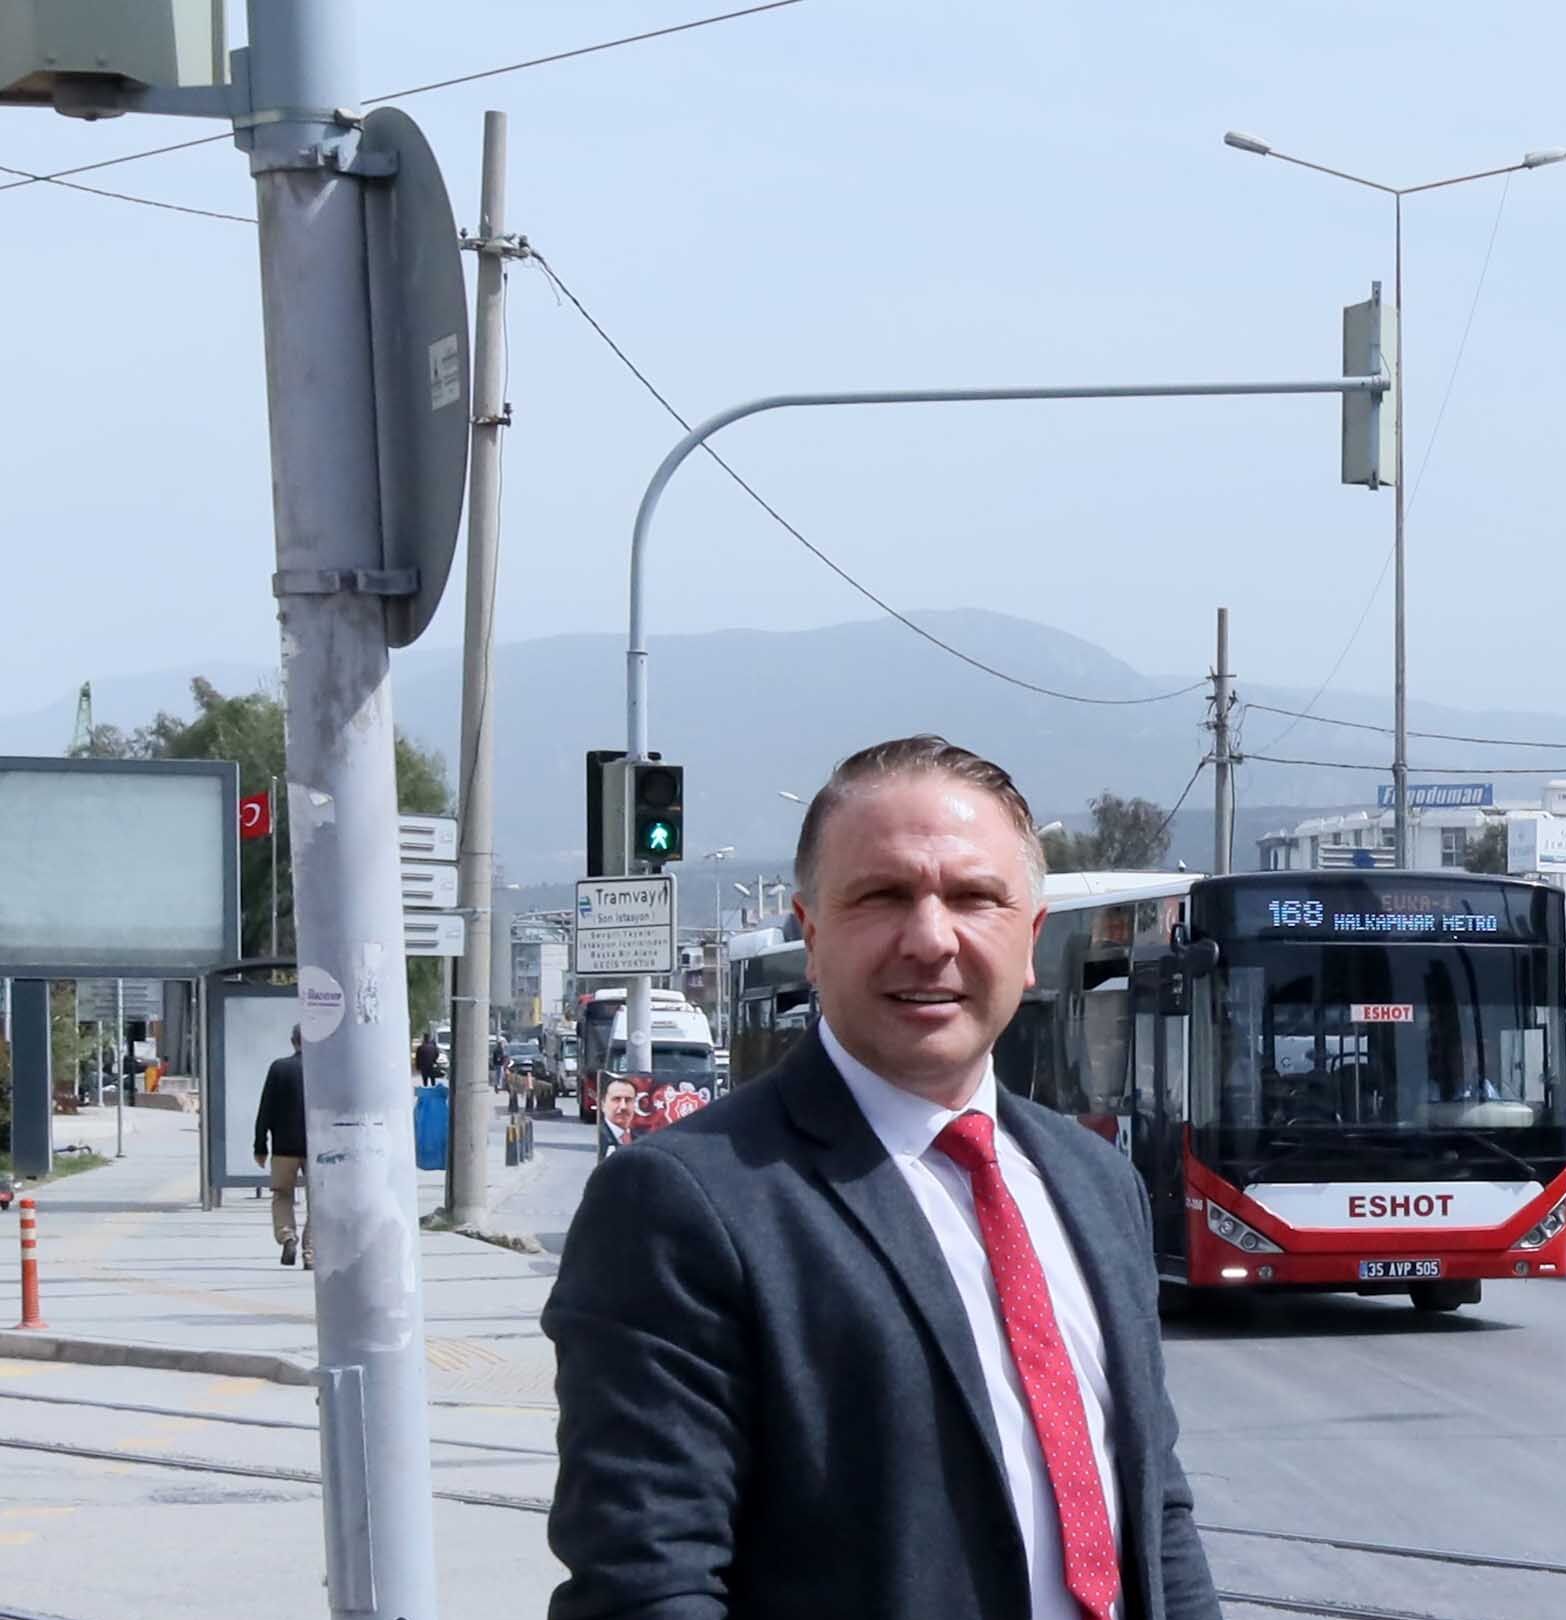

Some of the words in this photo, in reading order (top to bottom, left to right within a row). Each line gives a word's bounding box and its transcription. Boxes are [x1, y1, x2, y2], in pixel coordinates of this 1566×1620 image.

[596, 888, 656, 907] Tramvay
[1268, 900, 1324, 927] 168
[1442, 914, 1498, 932] METRO
[1364, 1006, 1411, 1020] ESHOT
[1348, 1195, 1454, 1218] ESHOT
[1368, 1262, 1384, 1276] 35
[1389, 1262, 1413, 1276] AVP
[1416, 1261, 1439, 1275] 505
